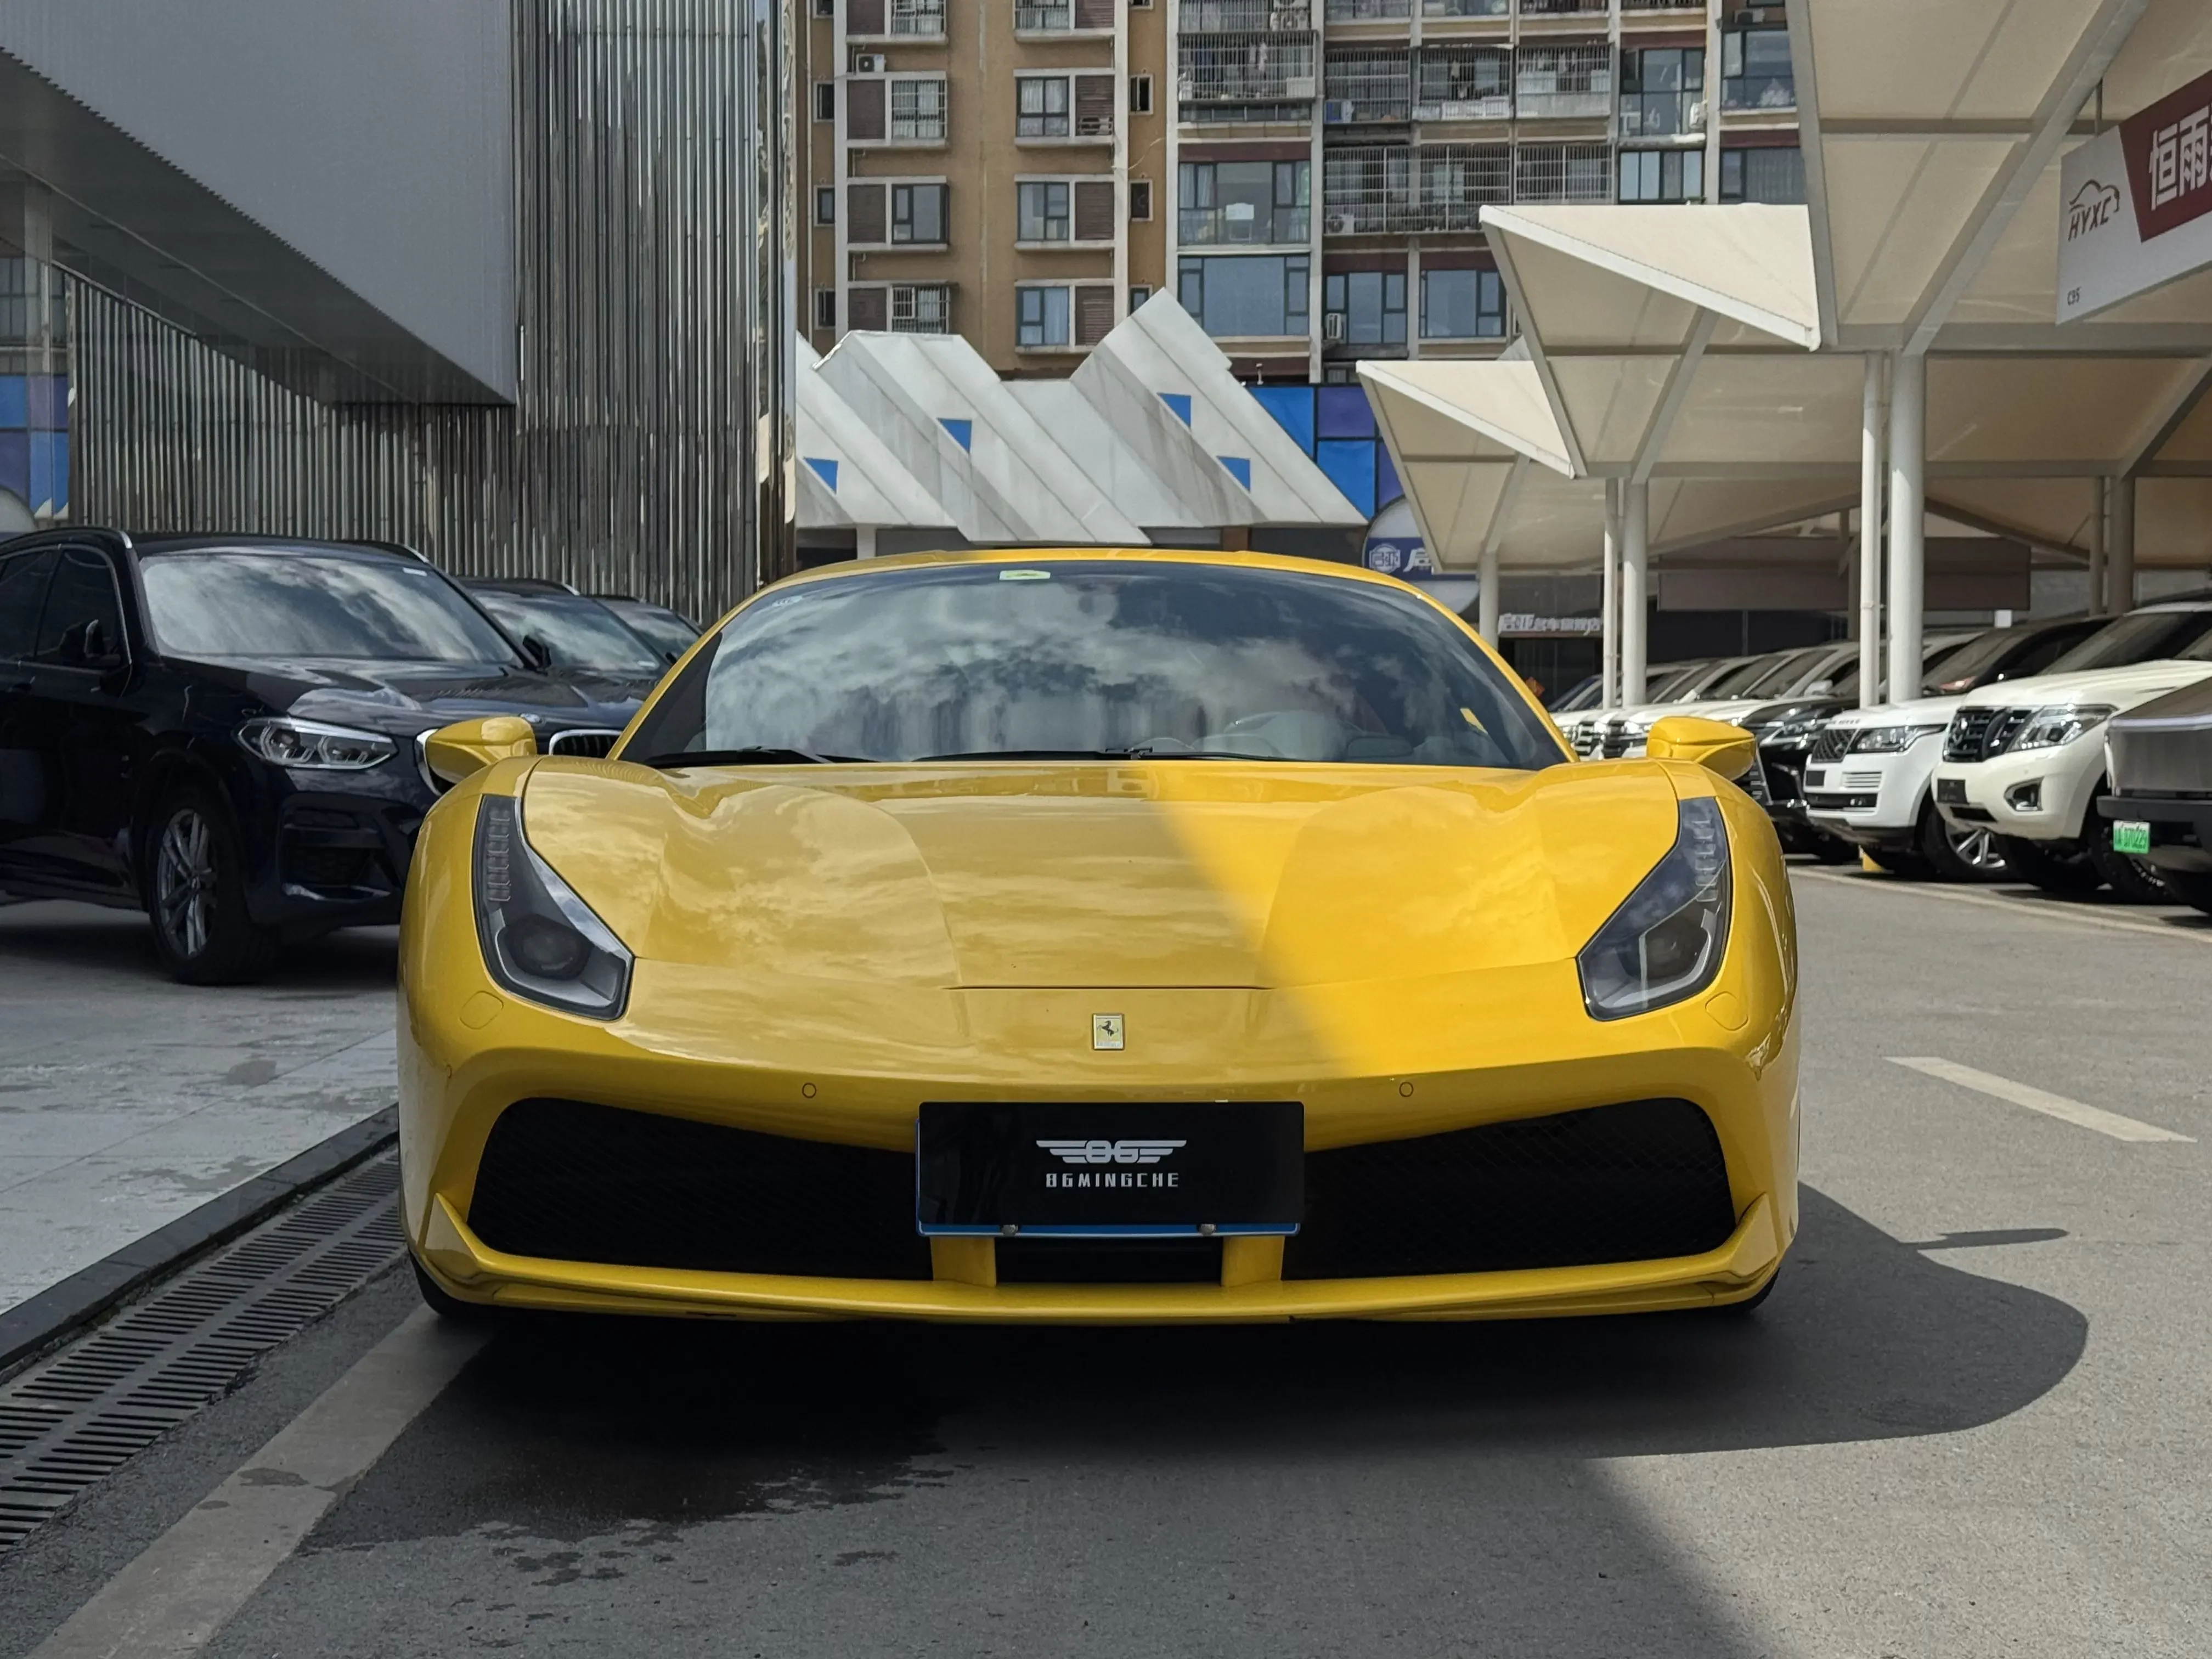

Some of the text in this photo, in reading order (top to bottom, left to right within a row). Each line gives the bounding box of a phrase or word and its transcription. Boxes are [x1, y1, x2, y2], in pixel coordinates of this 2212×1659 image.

[2148, 103, 2212, 211] 恒雨
[2068, 196, 2112, 242] HYXC
[1046, 1173, 1179, 1188] 86MINGCHE
